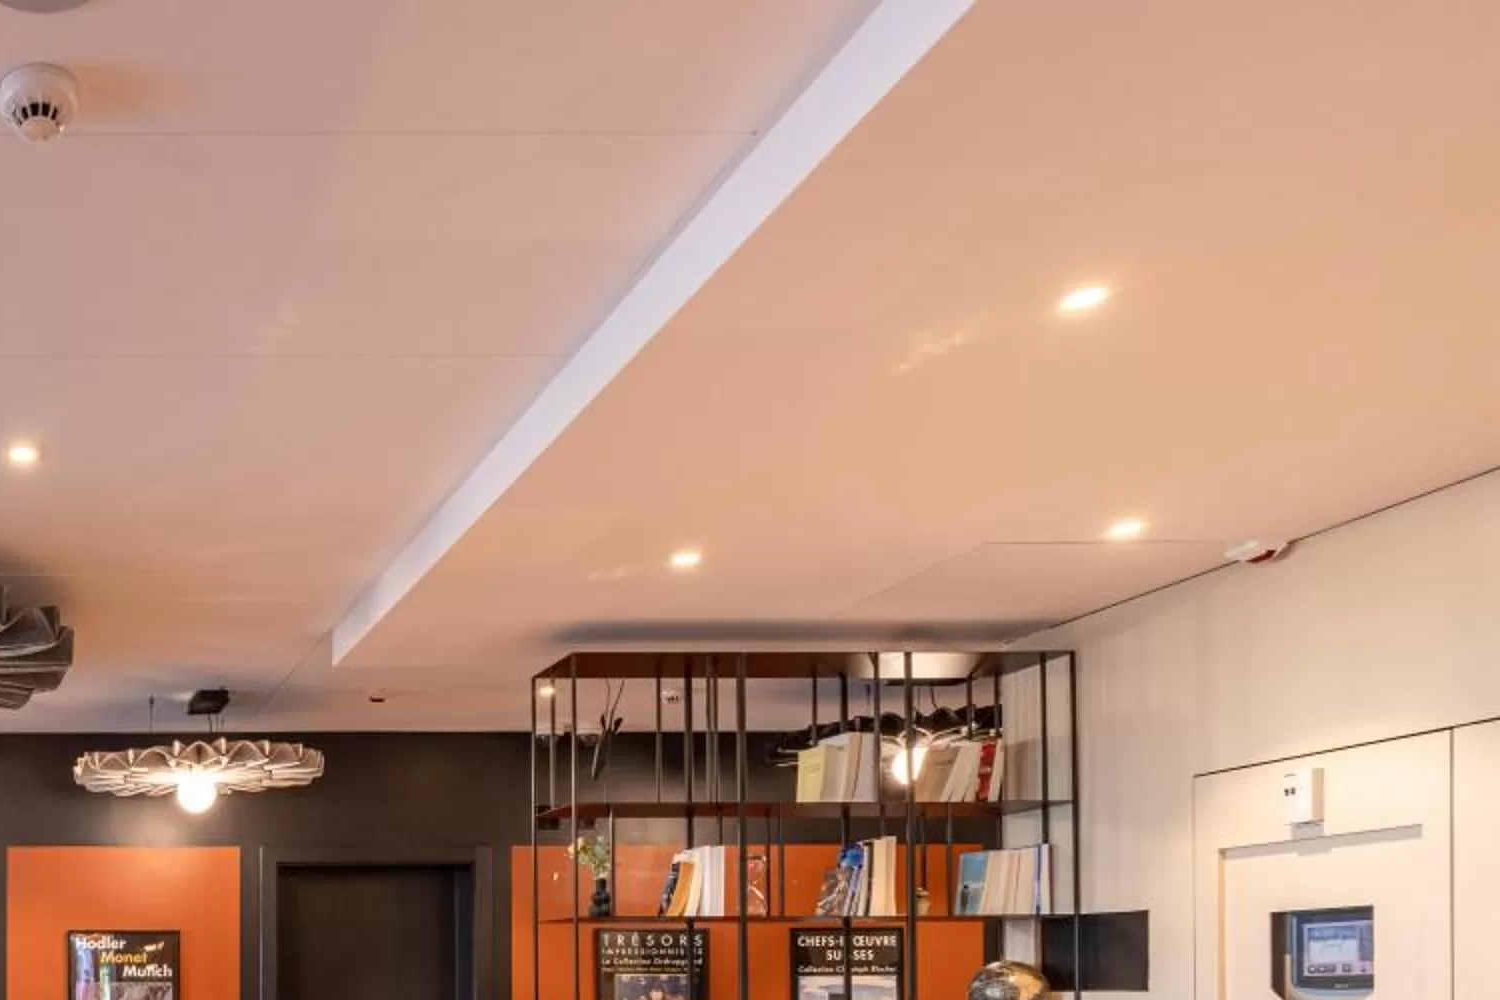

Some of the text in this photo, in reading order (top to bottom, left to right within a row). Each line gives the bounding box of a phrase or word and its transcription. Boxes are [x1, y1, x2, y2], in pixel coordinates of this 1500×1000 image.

[75, 935, 127, 950] Hodler
[603, 932, 703, 946] TRÉSORS
[797, 934, 897, 947] CHEFS-ŒUVRE
[100, 952, 148, 964] Monet
[826, 949, 875, 961] SUSES
